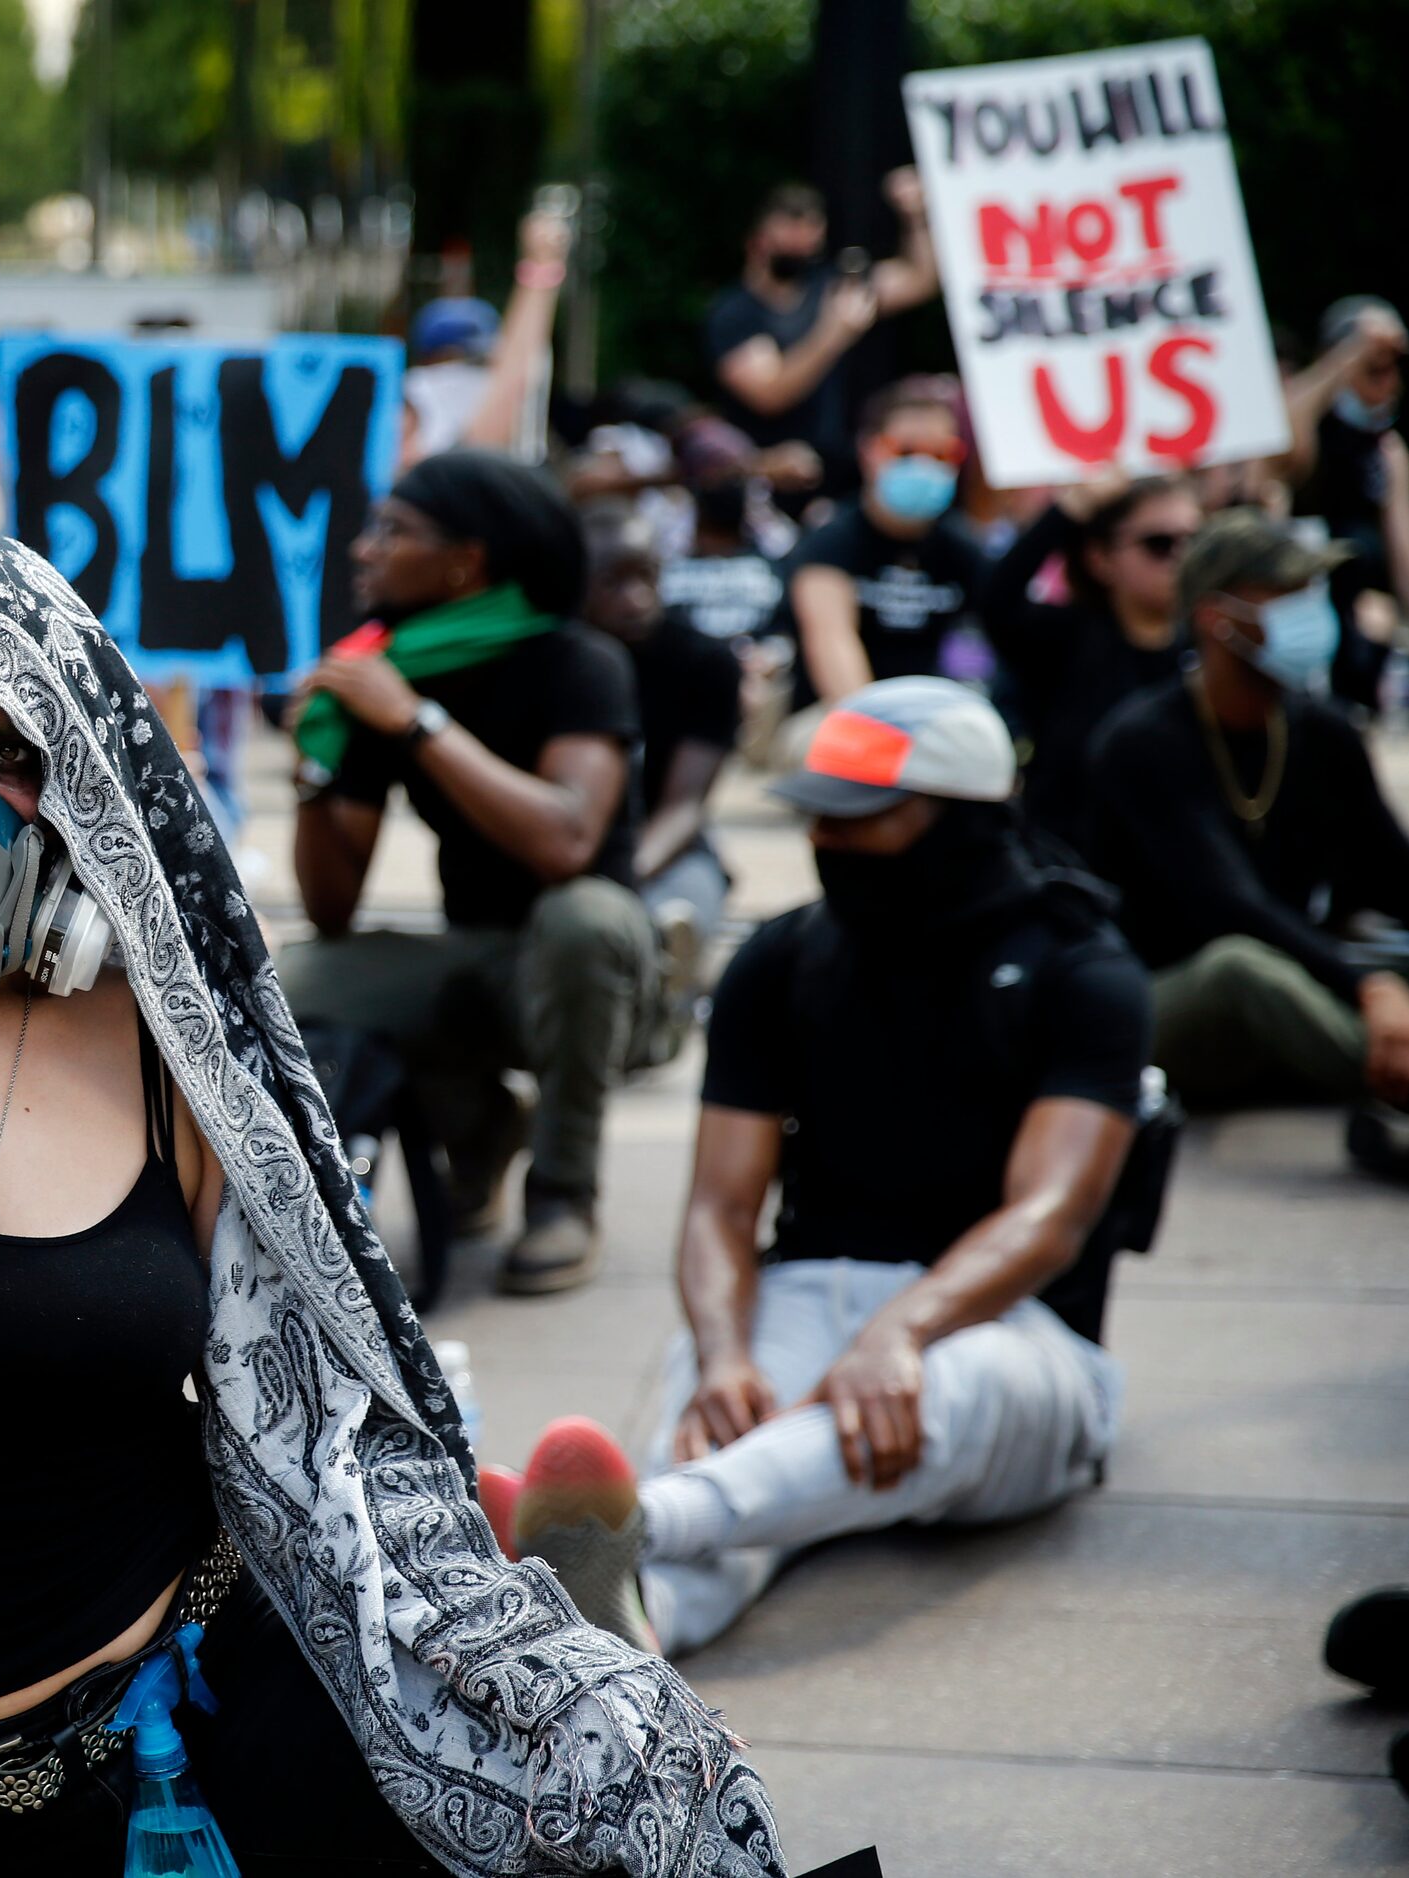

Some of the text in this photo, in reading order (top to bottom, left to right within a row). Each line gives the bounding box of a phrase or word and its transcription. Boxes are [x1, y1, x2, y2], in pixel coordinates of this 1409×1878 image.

[928, 71, 1220, 163] YOU WILL
[977, 175, 1180, 272] NOT
[978, 268, 1224, 342] SILENCE
[1032, 336, 1218, 466] US
[15, 352, 376, 675] BLM
